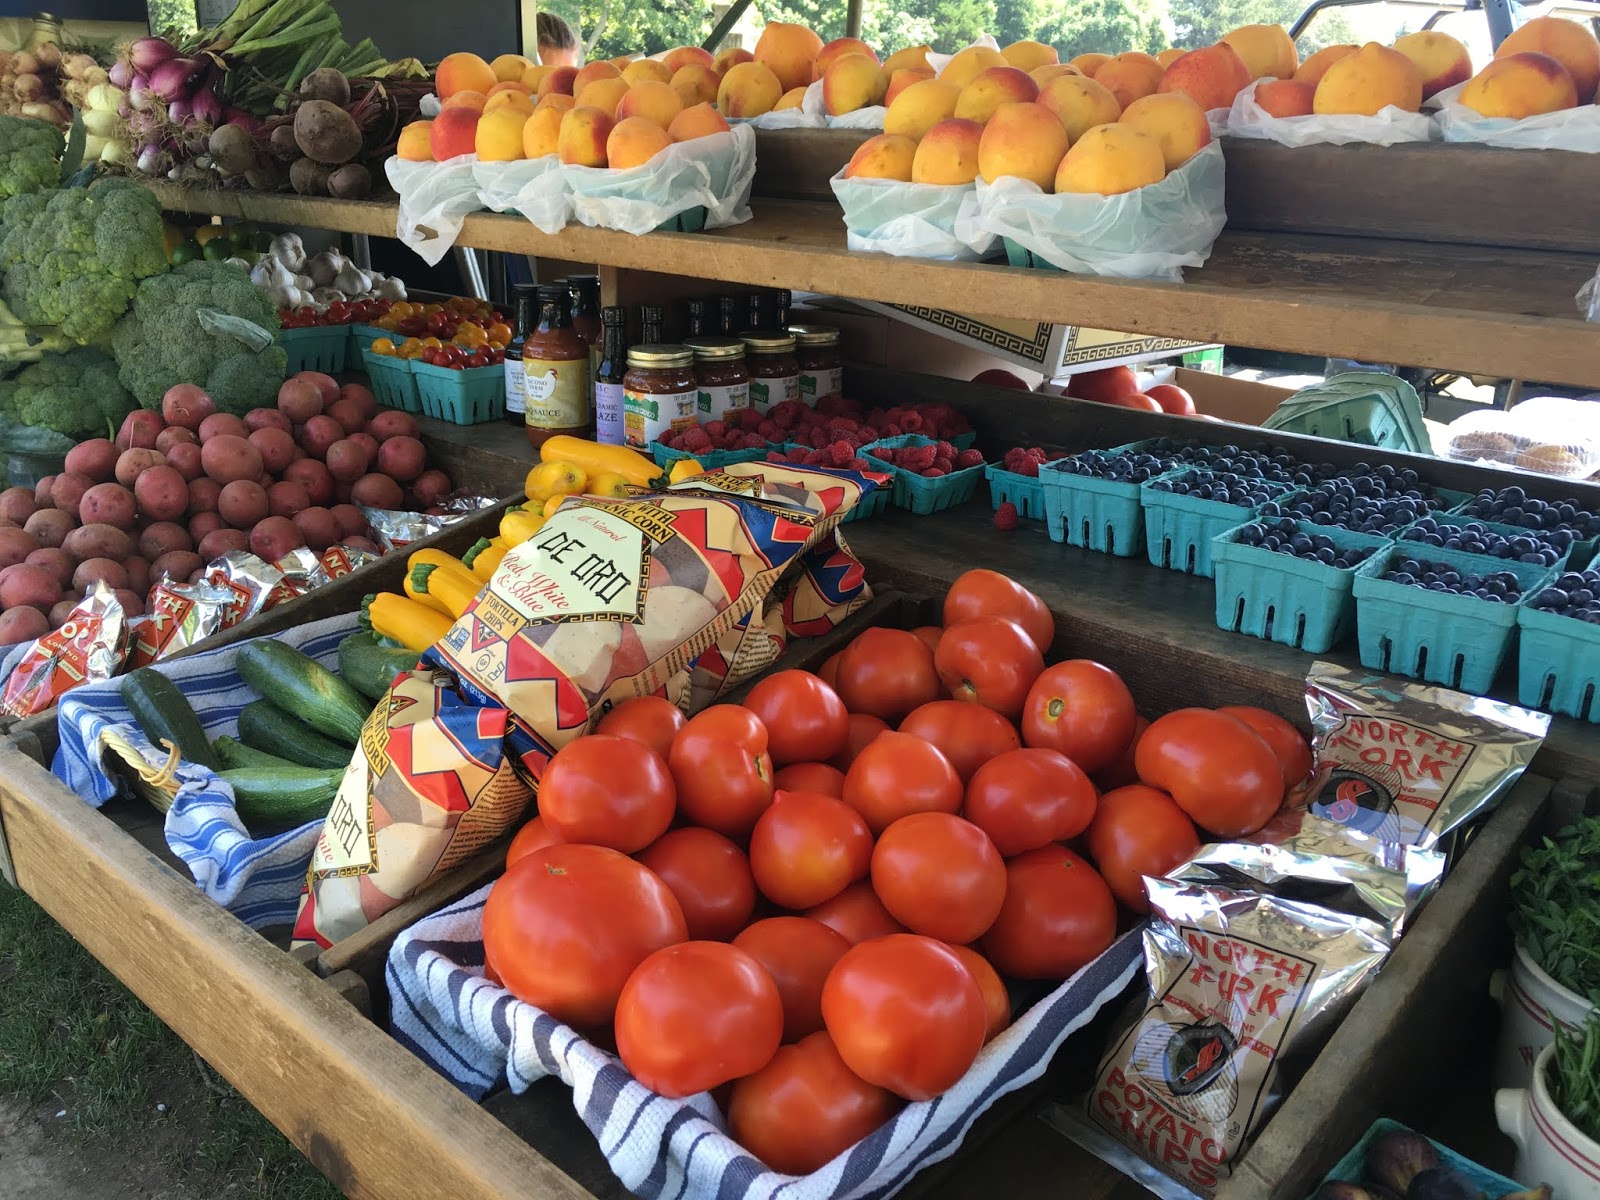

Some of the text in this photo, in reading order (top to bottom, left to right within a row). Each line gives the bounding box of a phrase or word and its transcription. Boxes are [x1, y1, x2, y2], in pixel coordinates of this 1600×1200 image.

[534, 408, 561, 417] SAUCE
[590, 519, 628, 542] Natural
[632, 513, 671, 541] CORN
[635, 502, 672, 524] WITH
[502, 552, 570, 611] Red, White
[537, 531, 631, 604] DE ORO
[485, 595, 520, 628] TORTILLA
[508, 580, 545, 613] Blue
[483, 610, 506, 632] CHIPS
[375, 717, 389, 748] WITH
[1346, 719, 1464, 760] NORTH
[364, 735, 387, 774] CORN
[1330, 734, 1451, 782] FORK
[331, 794, 363, 858] ORO
[318, 832, 334, 864] hite
[1187, 933, 1305, 985] NORTH
[1106, 1066, 1227, 1167] POTATO
[1098, 1090, 1218, 1188] CHIPS
